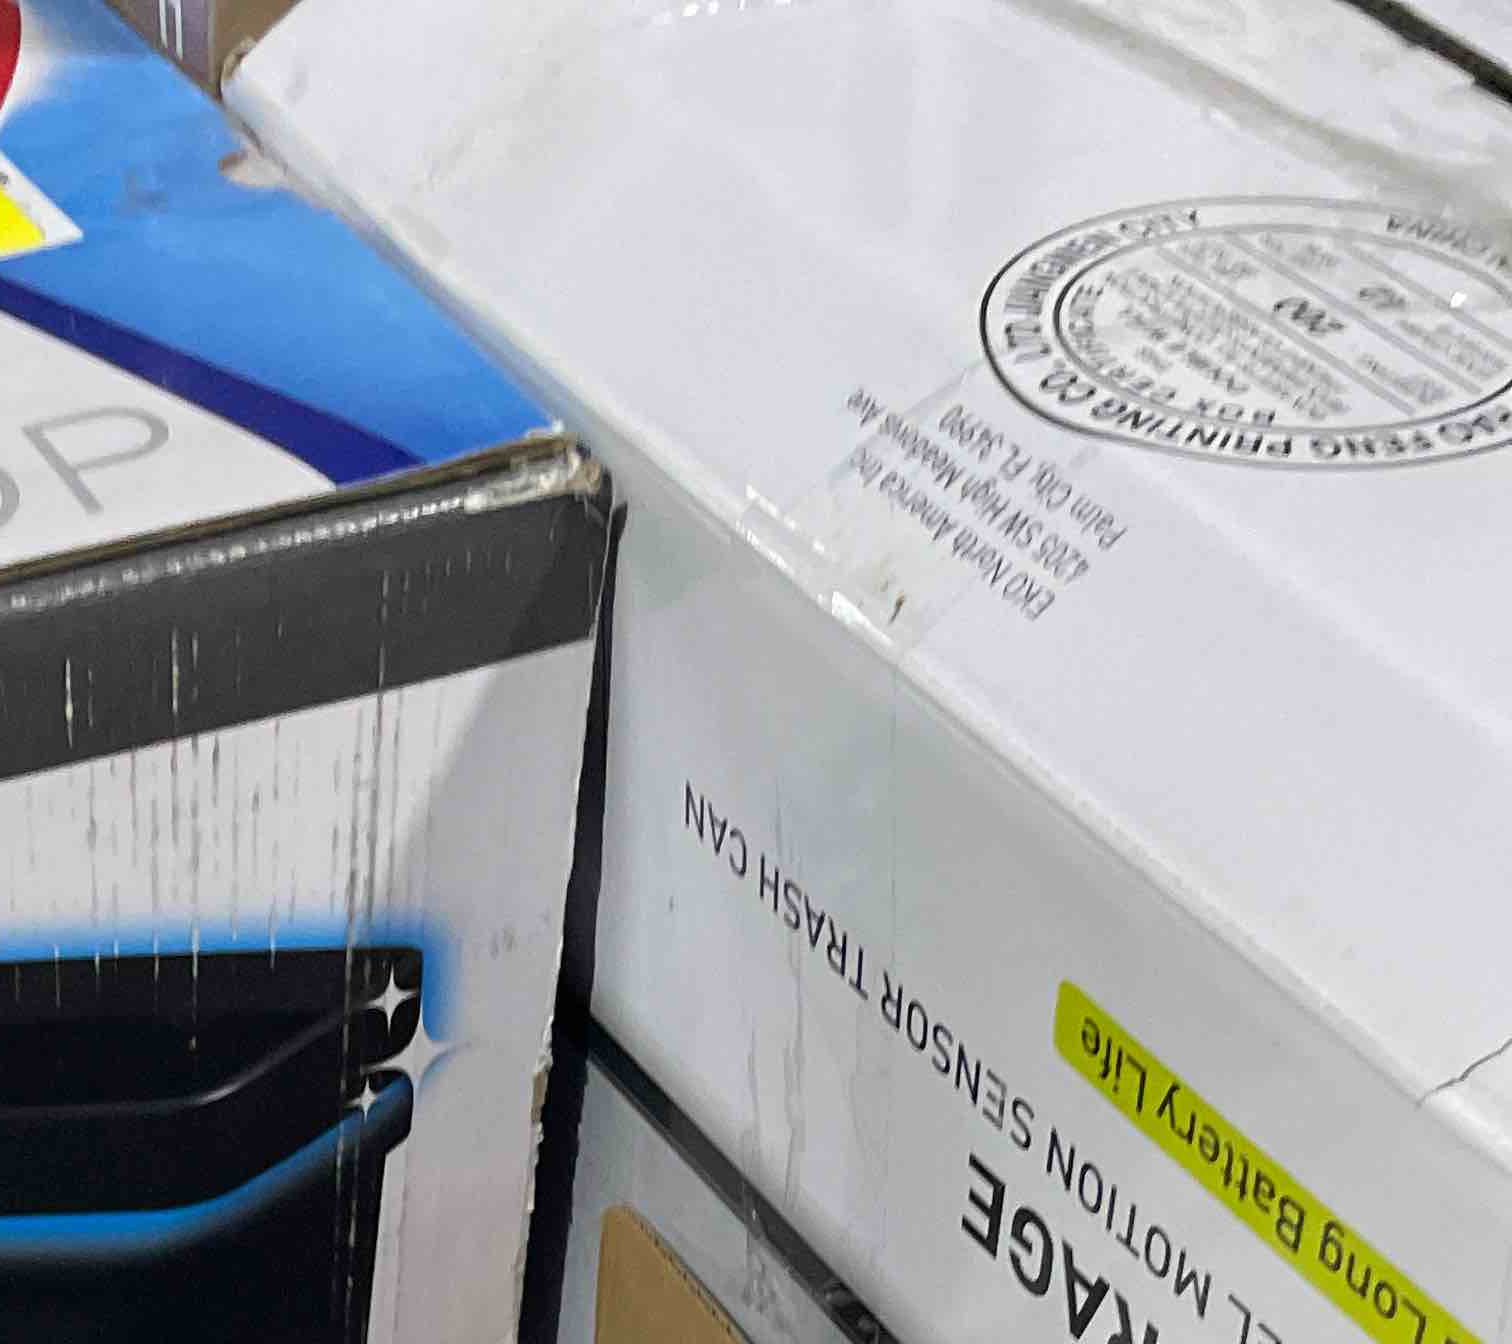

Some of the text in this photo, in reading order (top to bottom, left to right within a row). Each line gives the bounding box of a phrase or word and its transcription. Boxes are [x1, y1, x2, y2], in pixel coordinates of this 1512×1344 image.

[877, 413, 965, 491] Meadows
[999, 442, 1032, 481] FL
[1090, 397, 1294, 459] PRINTING
[878, 471, 958, 543] America
[960, 475, 1011, 526] High
[999, 508, 1044, 550] SW
[1068, 496, 1128, 552] Palm
[953, 528, 1013, 588] North
[1000, 571, 1056, 622] EKO
[681, 779, 749, 879] CAN
[755, 854, 870, 997] TRASH
[879, 969, 1035, 1149] SENSOR
[1072, 1013, 1155, 1125] Life
[1152, 1086, 1307, 1254] Battery
[1047, 1125, 1215, 1318] MOTION
